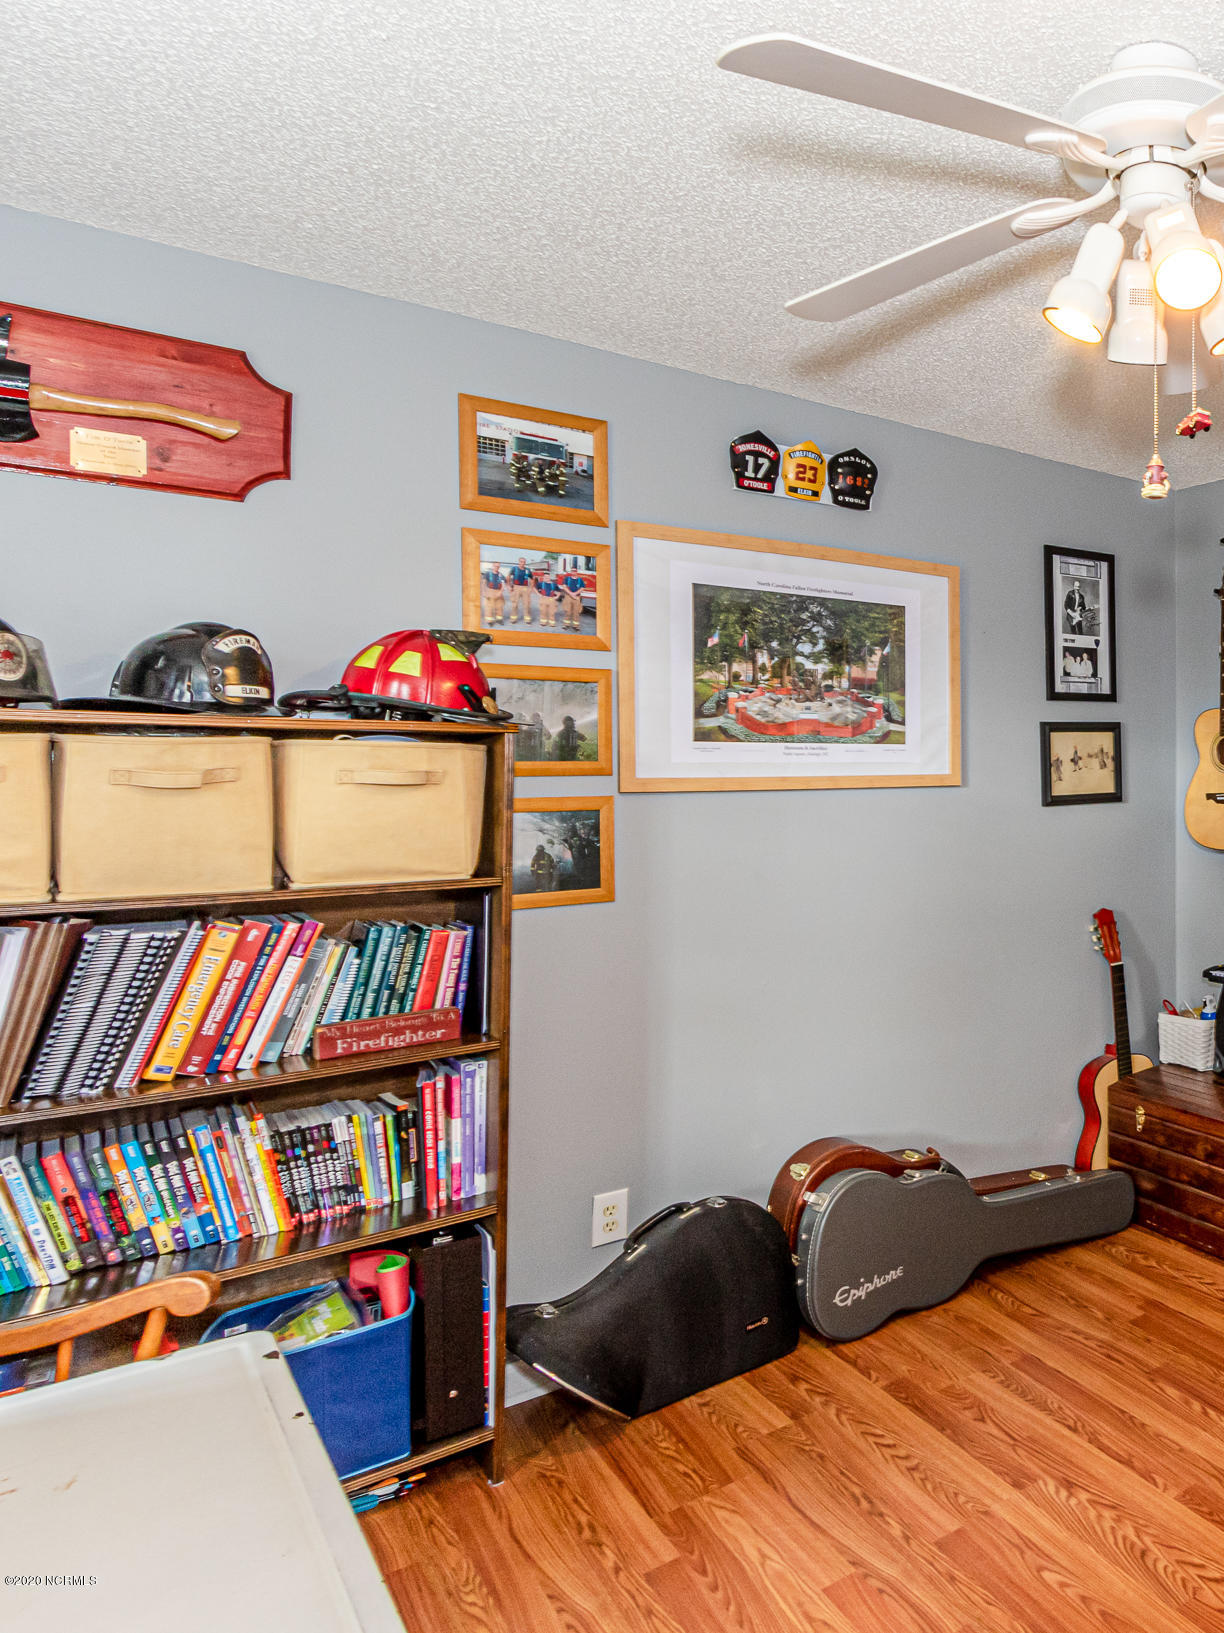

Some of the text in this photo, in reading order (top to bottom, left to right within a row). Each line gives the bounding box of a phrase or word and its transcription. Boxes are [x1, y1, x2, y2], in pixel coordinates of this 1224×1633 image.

[744, 454, 771, 479] 17
[794, 462, 818, 484] 23
[838, 456, 871, 468] ONSLOW
[241, 687, 260, 696] ELKIN
[166, 951, 222, 1051] Emergency Care
[346, 1022, 381, 1035] Heart
[430, 1012, 445, 1022] To
[447, 1011, 456, 1020] A
[335, 1029, 447, 1054] Firefighter
[424, 1110, 433, 1130] COMIC
[425, 1130, 434, 1147] BOOK
[832, 1266, 904, 1307] Epiphone
